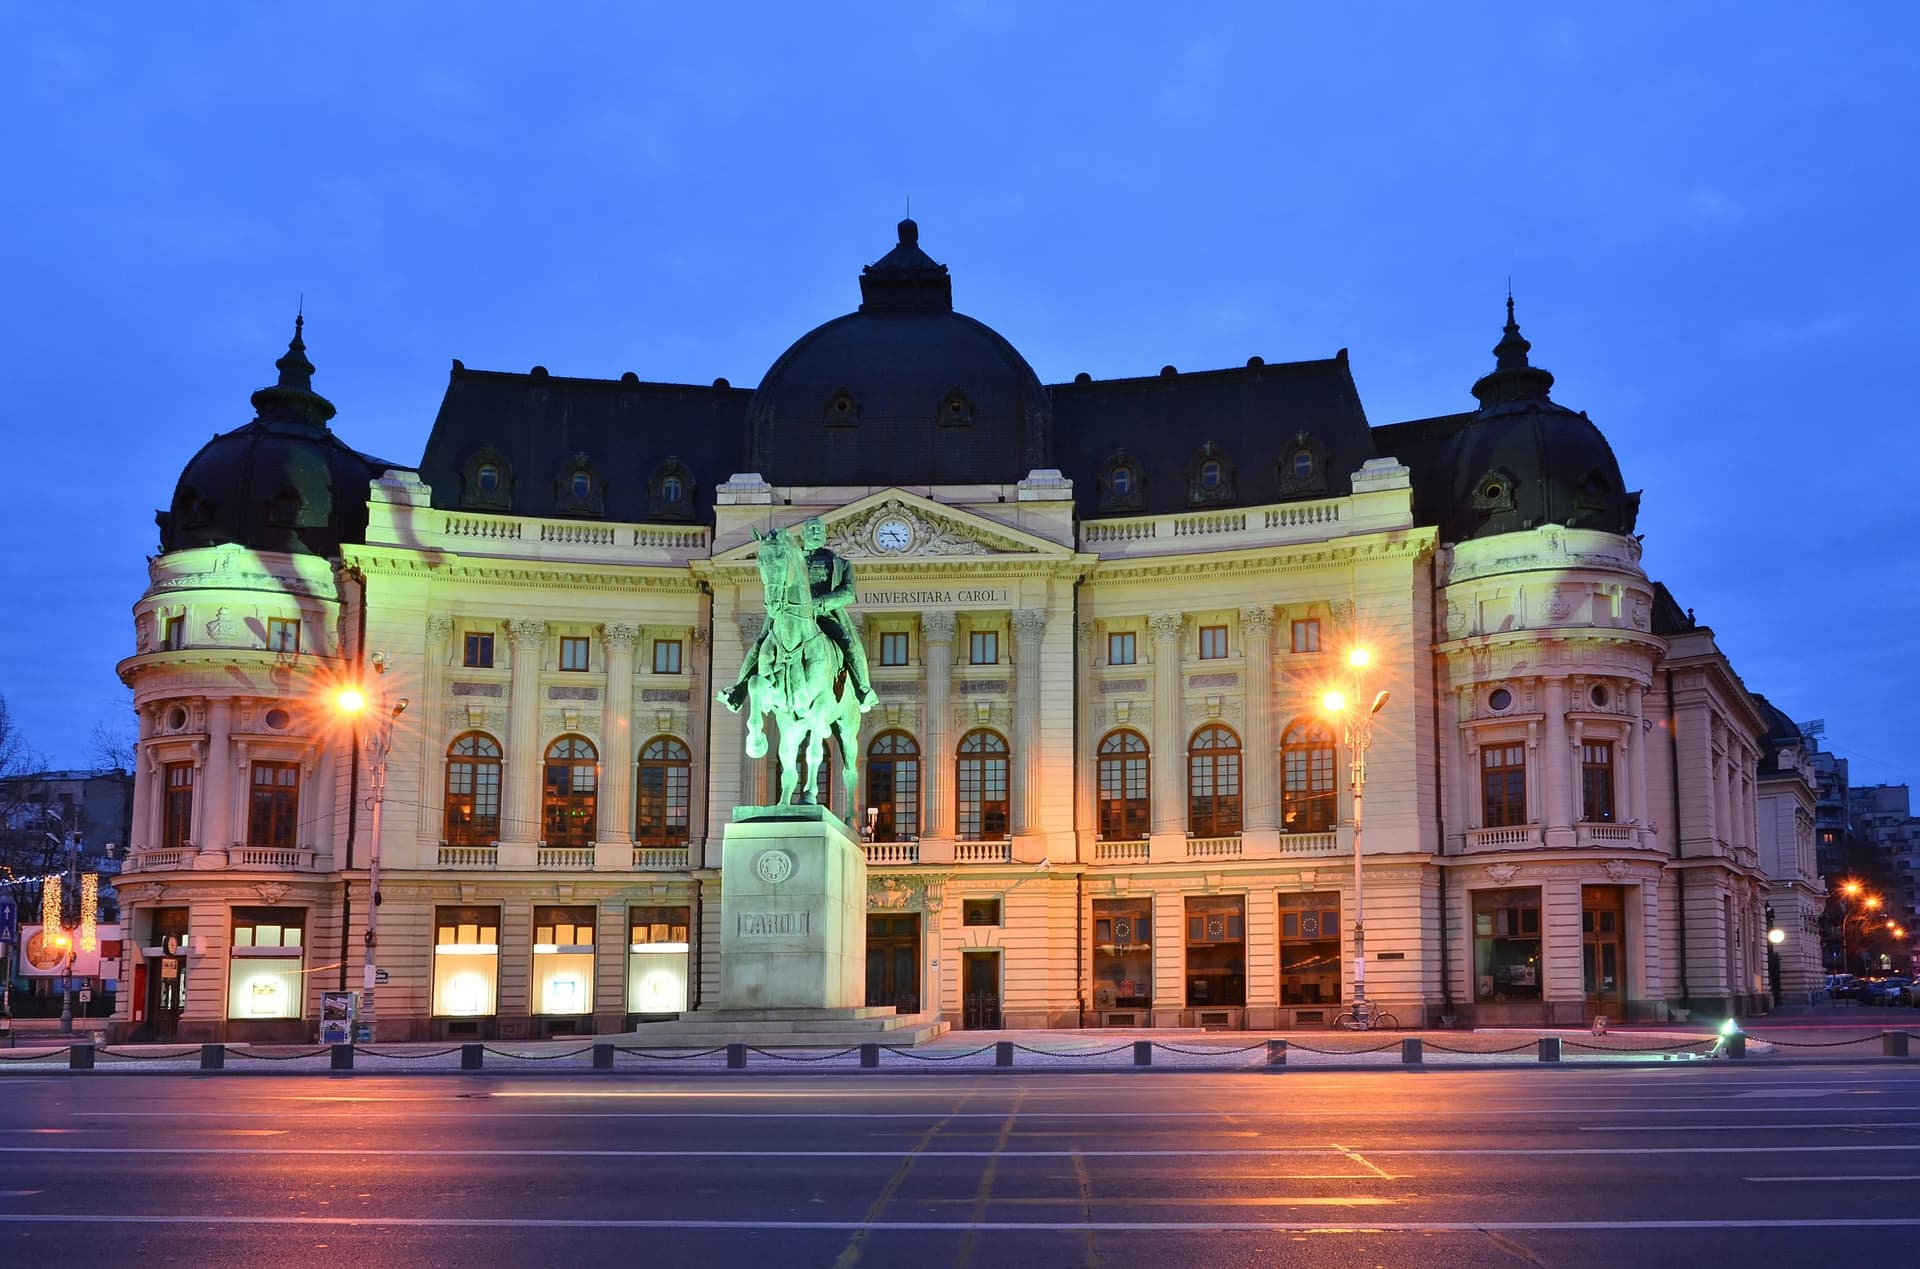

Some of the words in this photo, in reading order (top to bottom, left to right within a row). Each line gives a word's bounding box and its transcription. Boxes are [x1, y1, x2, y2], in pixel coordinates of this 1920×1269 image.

[864, 591, 952, 604] UNIVERSITARA
[957, 590, 998, 602] CAROL
[1003, 589, 1008, 601] I
